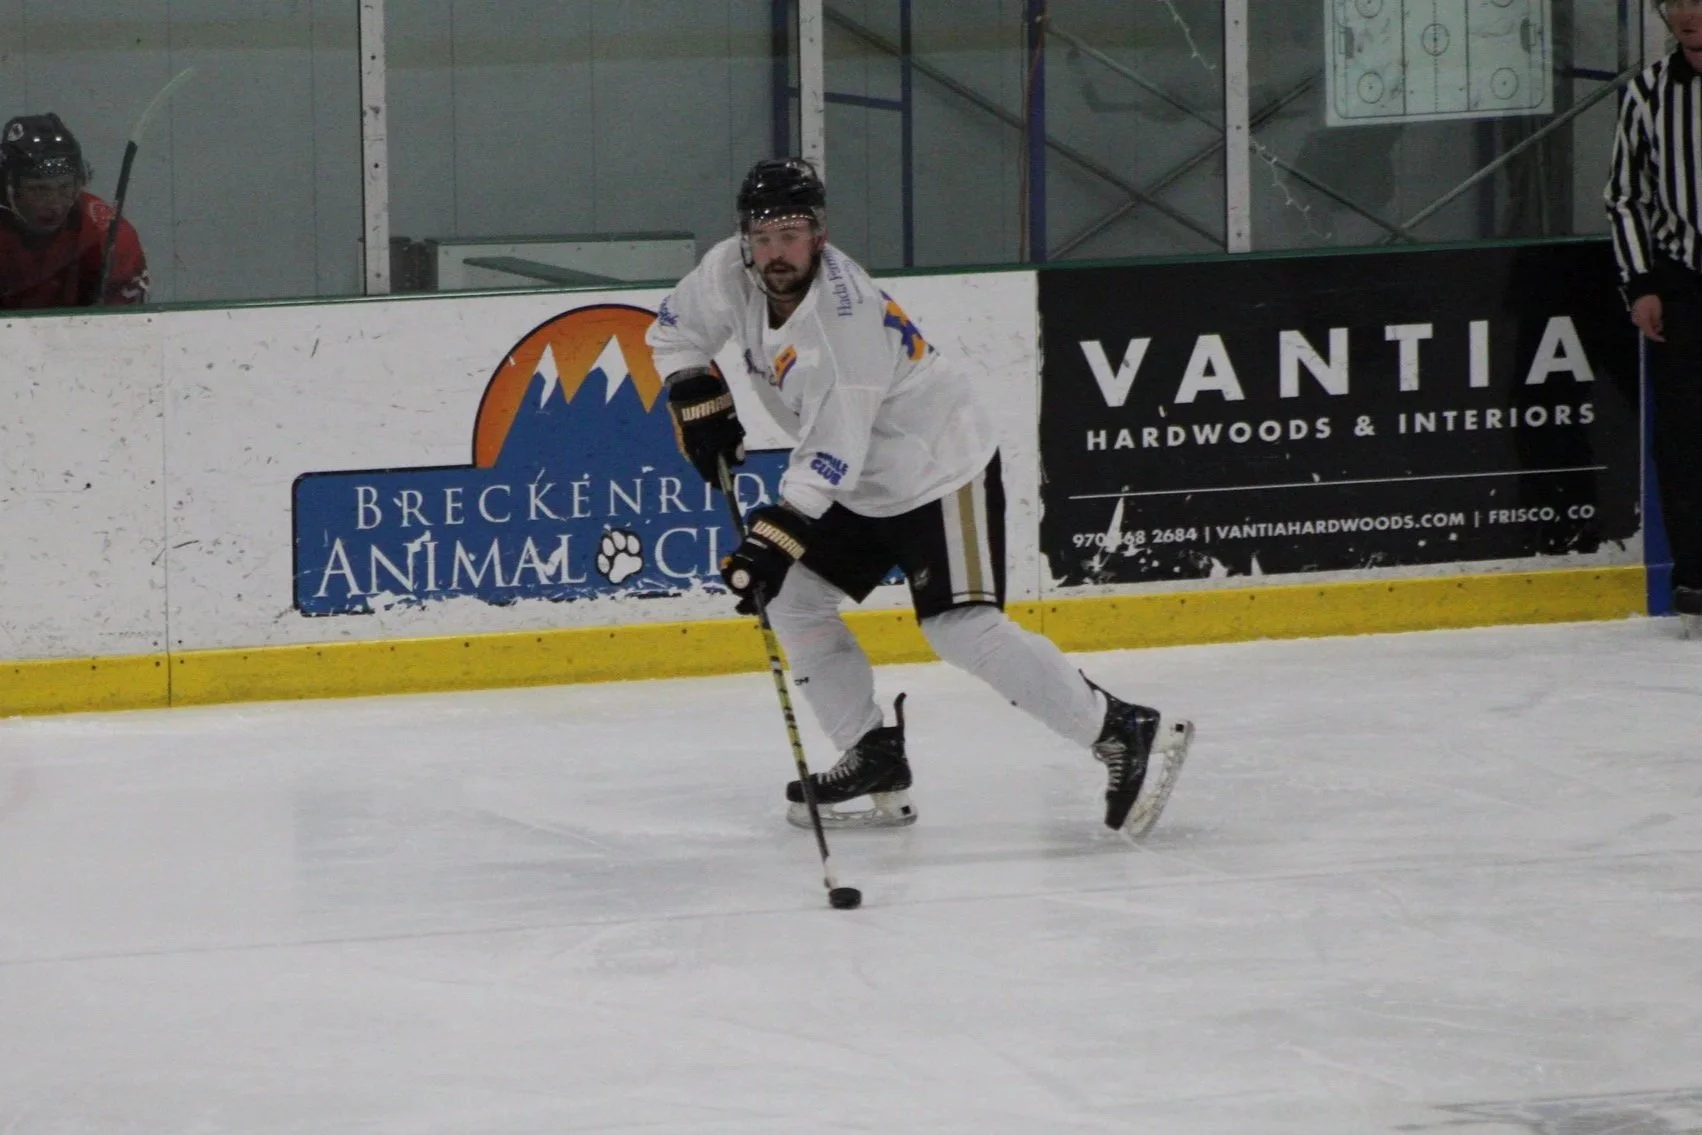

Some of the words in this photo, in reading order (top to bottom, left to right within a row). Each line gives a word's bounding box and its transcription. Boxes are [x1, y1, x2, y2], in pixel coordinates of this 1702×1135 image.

[1078, 315, 1596, 408] VANTIA
[1087, 417, 1333, 451] HARDWOODS
[1354, 414, 1376, 437] &
[1399, 403, 1597, 434] INTERIORS
[810, 458, 842, 486] CLUB
[355, 472, 784, 531] BRECKENRID
[1110, 530, 1146, 546] 68
[1151, 527, 1198, 544] 2684
[1216, 511, 1465, 540] VANTIAHARDWOODS.COM
[1488, 507, 1561, 524] FRISCO,
[1567, 504, 1596, 520] CO
[312, 534, 587, 598] ANIMAL
